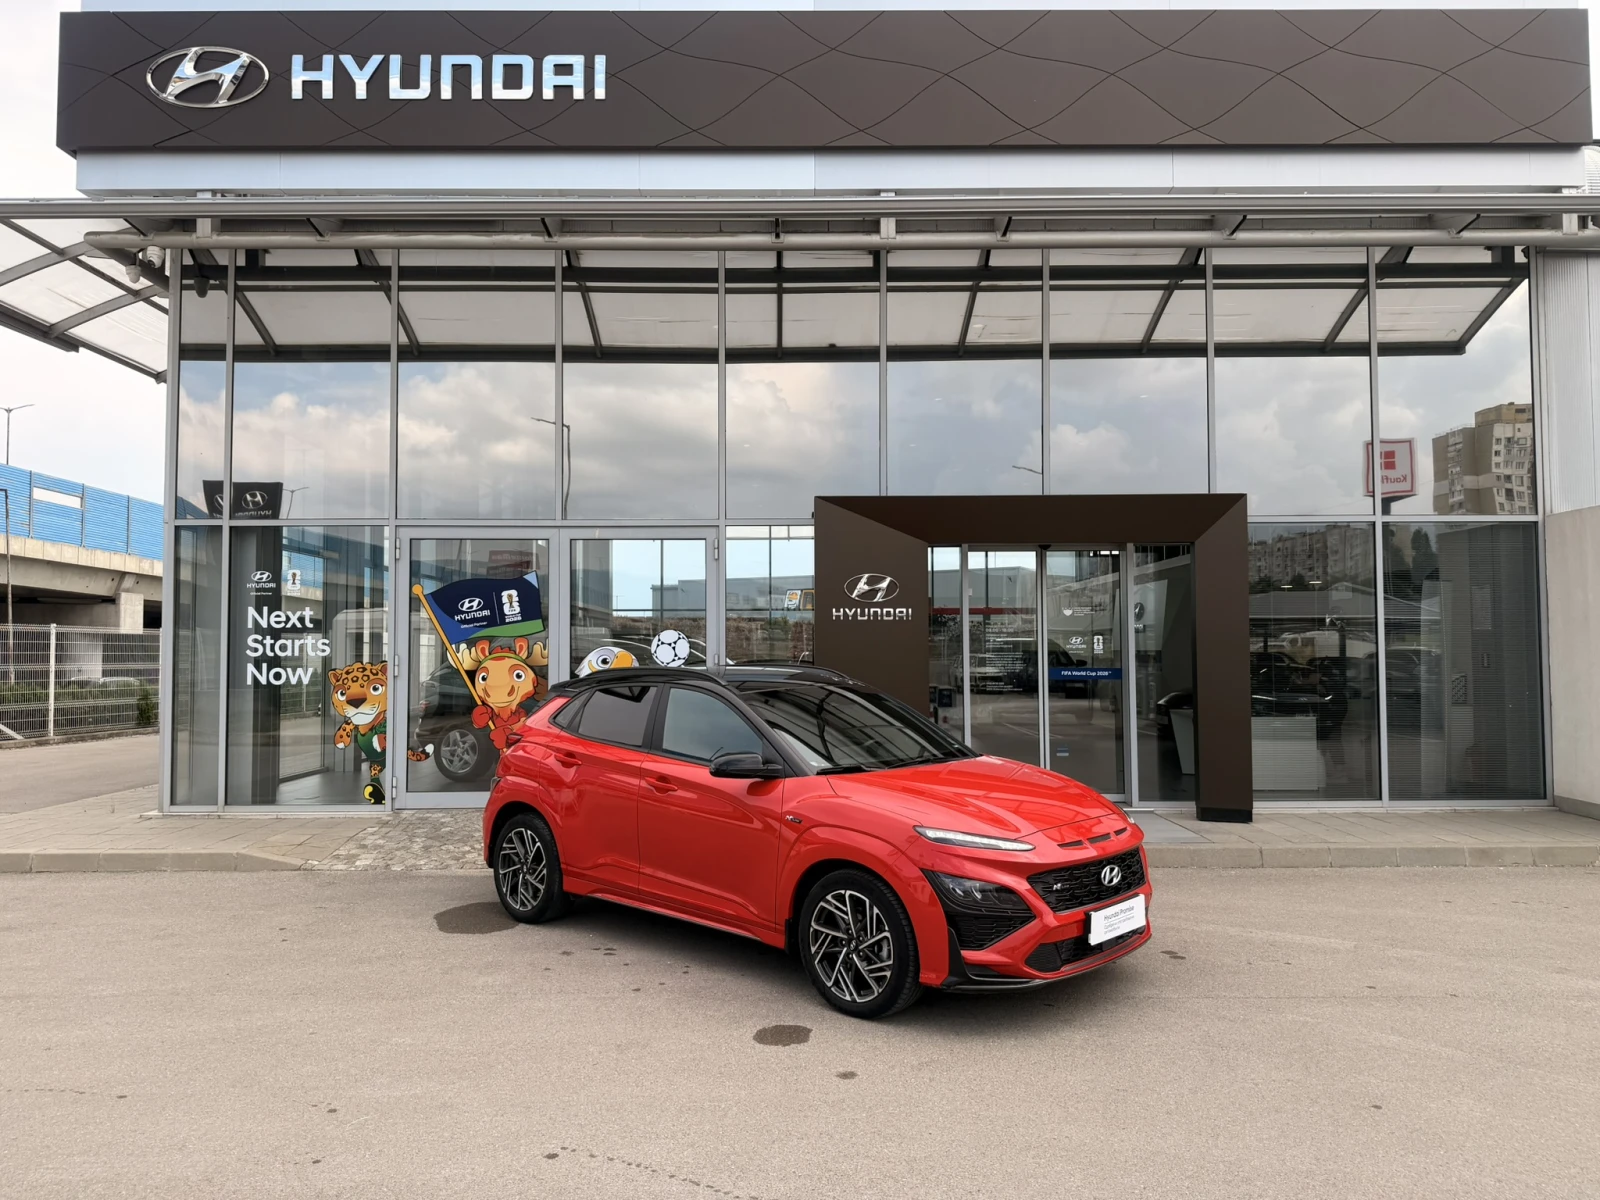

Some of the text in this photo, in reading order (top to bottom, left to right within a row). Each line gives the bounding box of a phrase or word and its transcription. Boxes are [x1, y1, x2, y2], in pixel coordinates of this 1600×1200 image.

[291, 54, 606, 100] HYUNDAI
[247, 606, 314, 628] Next
[454, 609, 490, 621] HYUNDAI
[832, 608, 912, 620] HYUNDAI
[245, 633, 331, 657] Starts
[246, 662, 313, 685] Now
